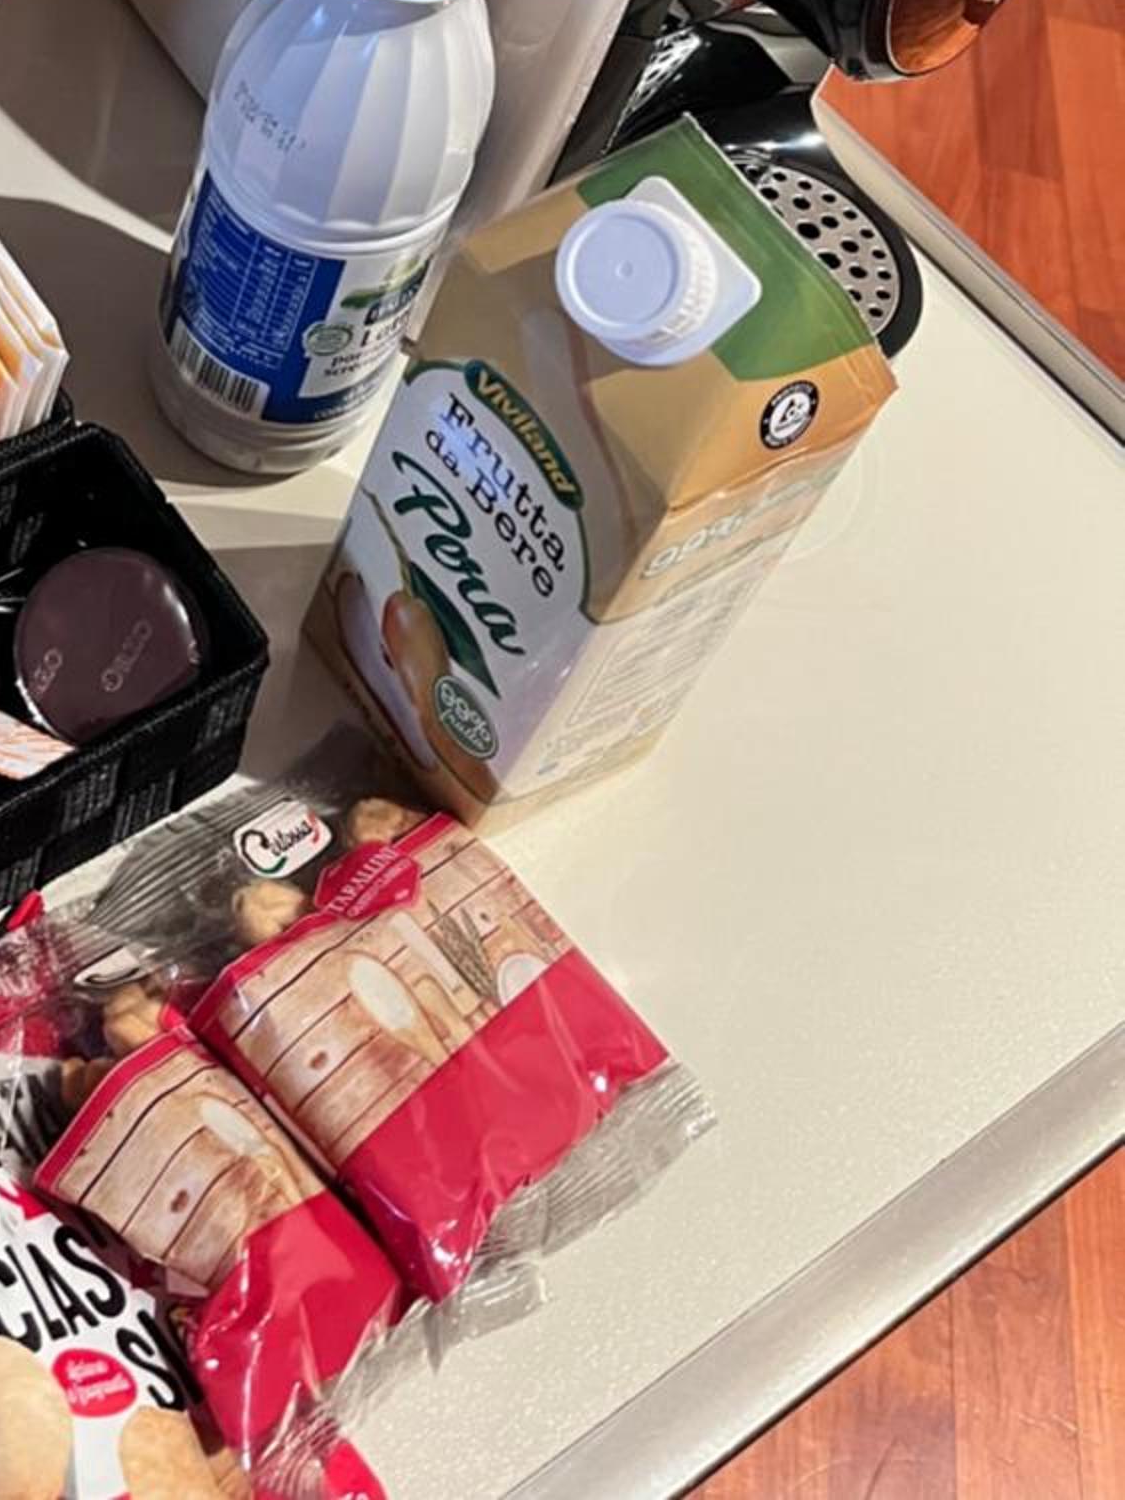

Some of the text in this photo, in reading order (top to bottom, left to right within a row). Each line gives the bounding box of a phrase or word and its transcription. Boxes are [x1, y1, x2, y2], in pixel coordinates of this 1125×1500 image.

[425, 430, 556, 598] da Bere
[441, 393, 566, 573] Frutta
[475, 371, 575, 494] Viviland
[392, 451, 526, 655] Pera
